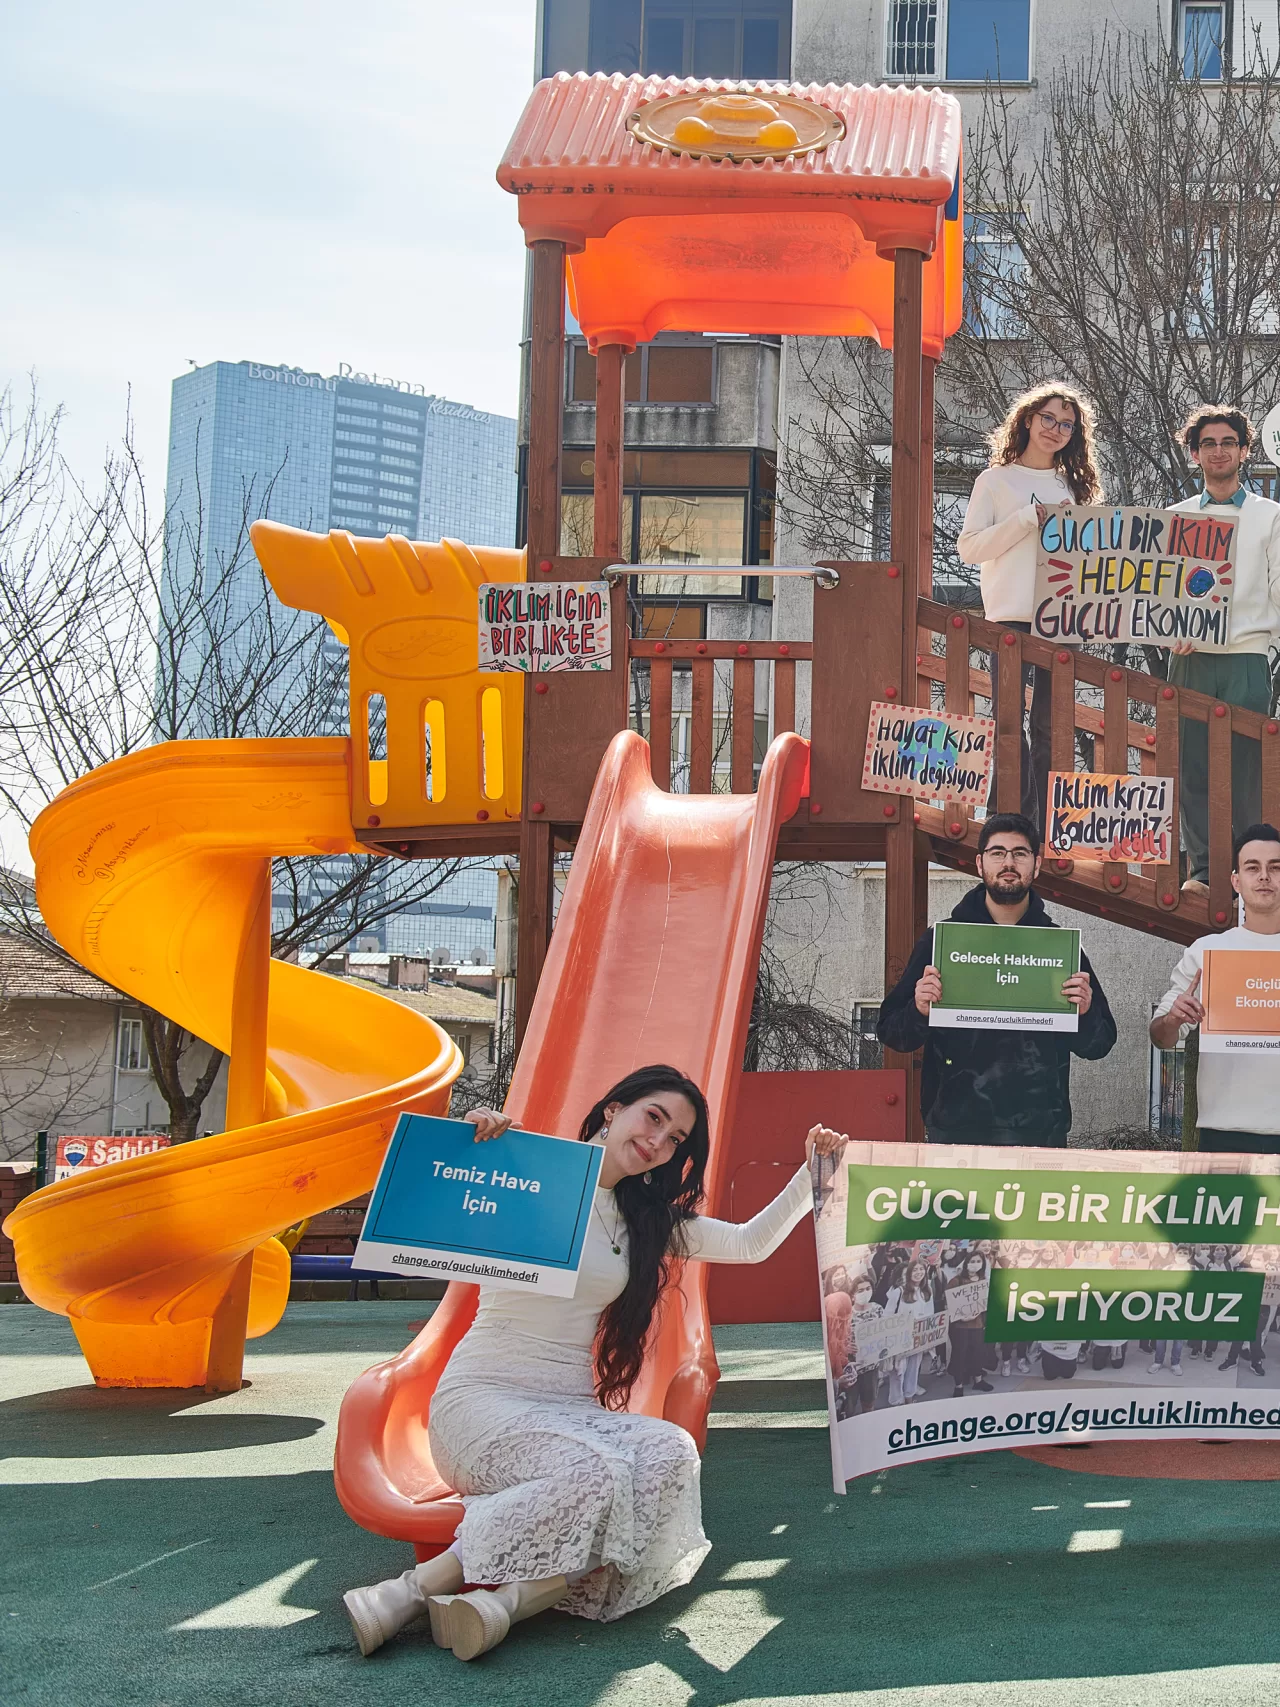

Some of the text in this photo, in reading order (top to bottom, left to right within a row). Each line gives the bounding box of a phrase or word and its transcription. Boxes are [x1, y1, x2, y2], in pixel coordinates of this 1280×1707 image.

[248, 362, 425, 398] Bomonti Rotana
[428, 396, 491, 424] Residences
[1041, 510, 1235, 561] GÜÇLÜ BİR İKLİM
[1079, 557, 1186, 599] HEDEFİ
[1035, 595, 1229, 646] GÜÇLÜ EKONOMİ
[877, 716, 938, 750] Hayat
[1113, 779, 1167, 811] krizi
[950, 951, 1063, 968] Gelecek Hakkımız
[996, 968, 1019, 985] İçin
[956, 1014, 1054, 1025] change.org/gucluiklimhedefi
[432, 1160, 541, 1194] Temiz Hava
[462, 1189, 498, 1215] İçin
[865, 1180, 1026, 1229] GÜÇLÜ
[1037, 1184, 1110, 1224] BİR
[1121, 1185, 1244, 1226] İKLİM
[391, 1253, 540, 1284] change.org/gucluiklimhedefi
[1006, 1281, 1243, 1323] İSTİYORUZ
